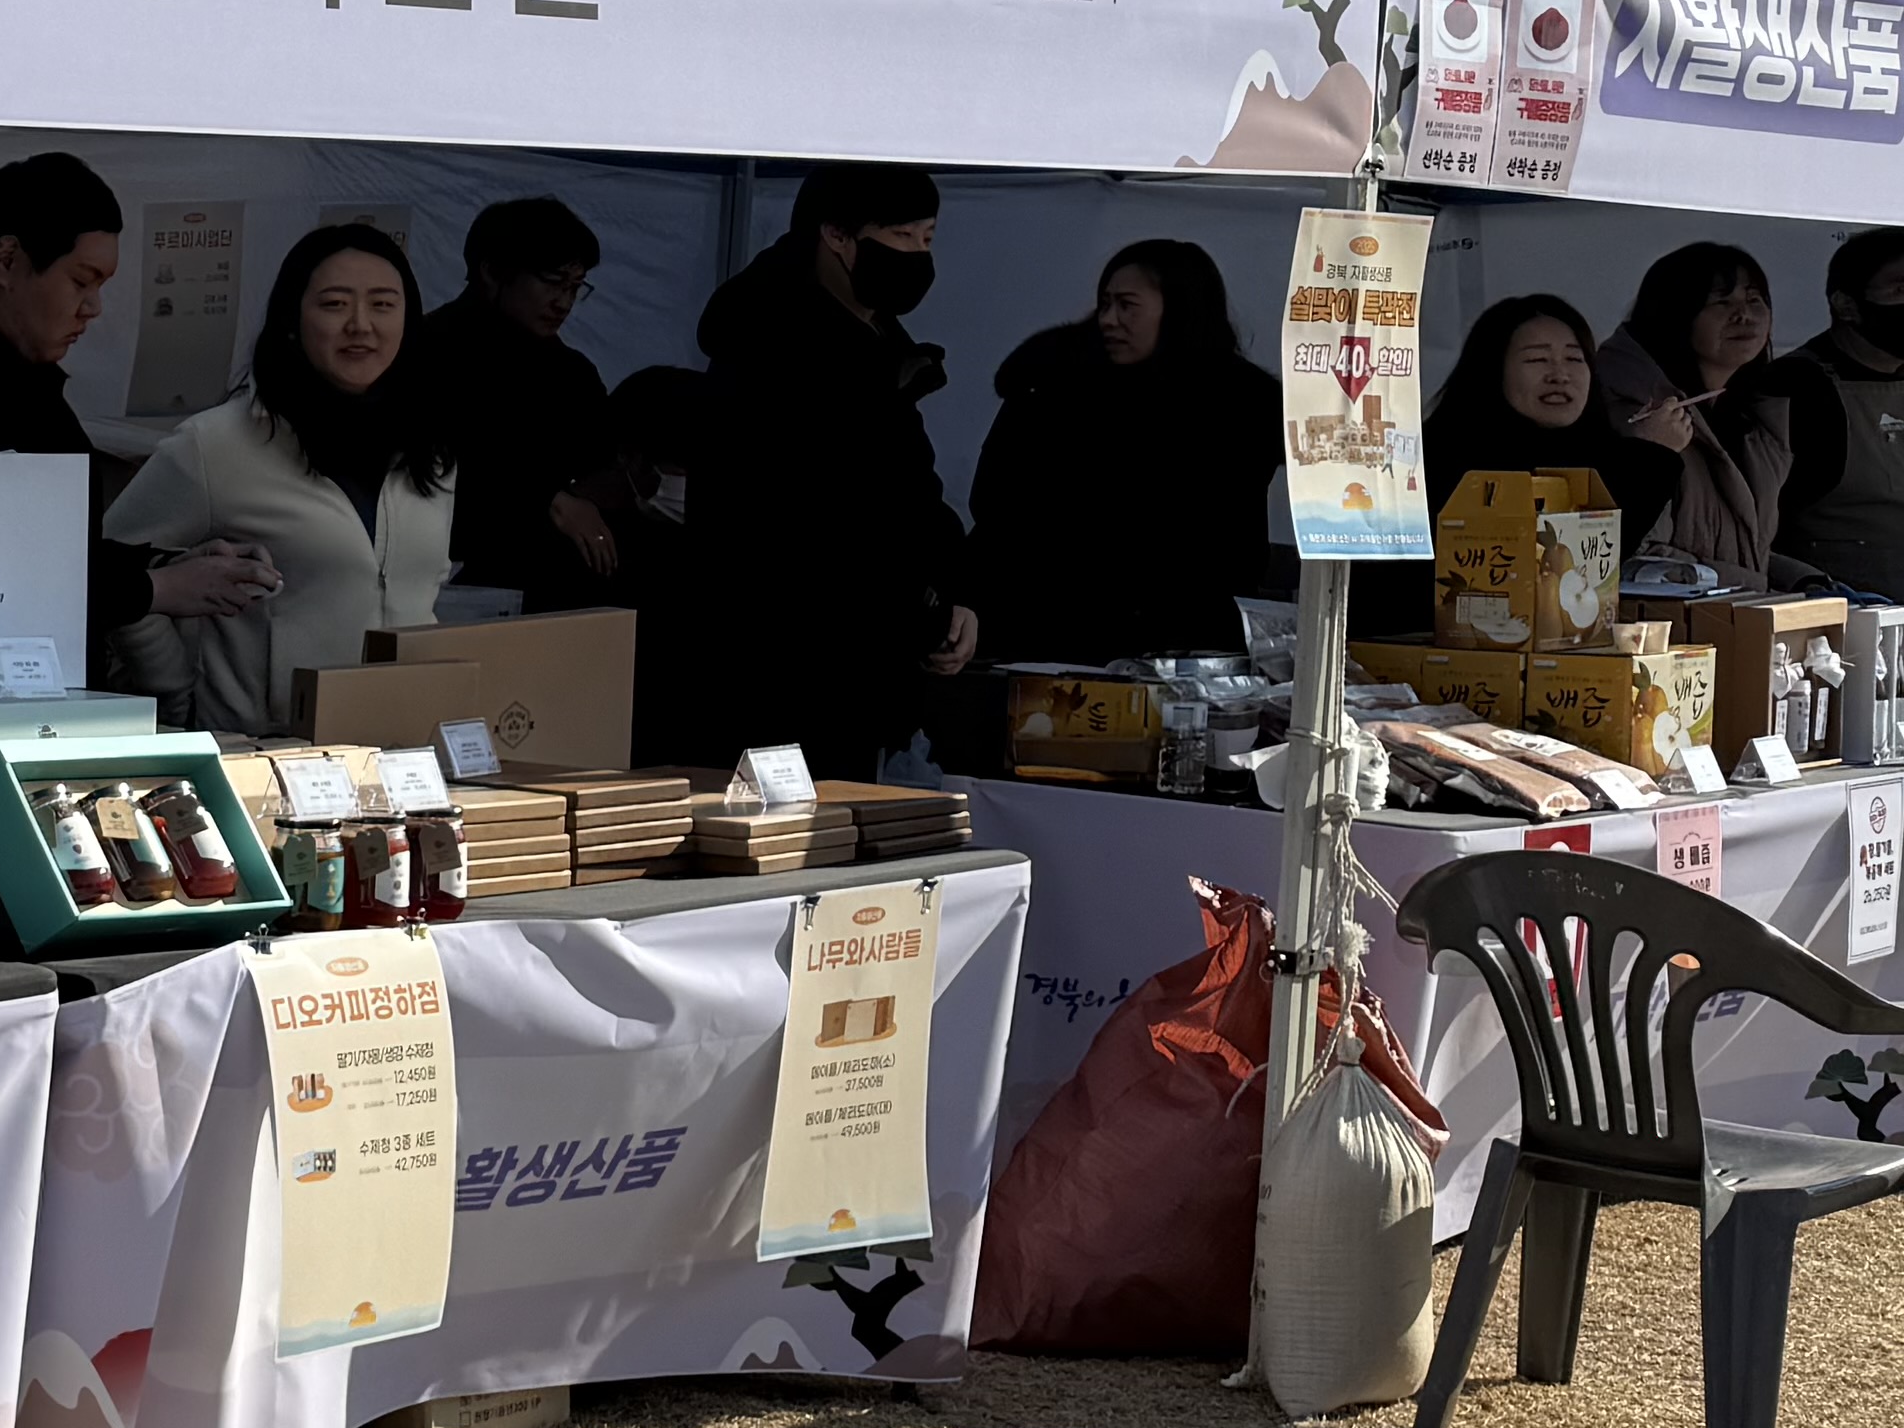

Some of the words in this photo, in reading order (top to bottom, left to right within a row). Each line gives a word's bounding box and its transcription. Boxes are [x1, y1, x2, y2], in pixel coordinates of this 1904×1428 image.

[1422, 148, 1454, 172] 선착순
[1506, 156, 1538, 179] 선착순
[1289, 285, 1359, 325] 설맞이
[1362, 289, 1418, 328] 특판전
[1294, 343, 1331, 374] 최대
[1377, 347, 1414, 377] 할인!
[1453, 544, 1516, 586] 배즙
[1545, 687, 1611, 728] 배즙
[806, 927, 922, 973] 나무와사람들
[270, 979, 441, 1032] 디오커피정하점
[359, 1139, 391, 1158] 수제청
[455, 1124, 689, 1213] 활생산품
